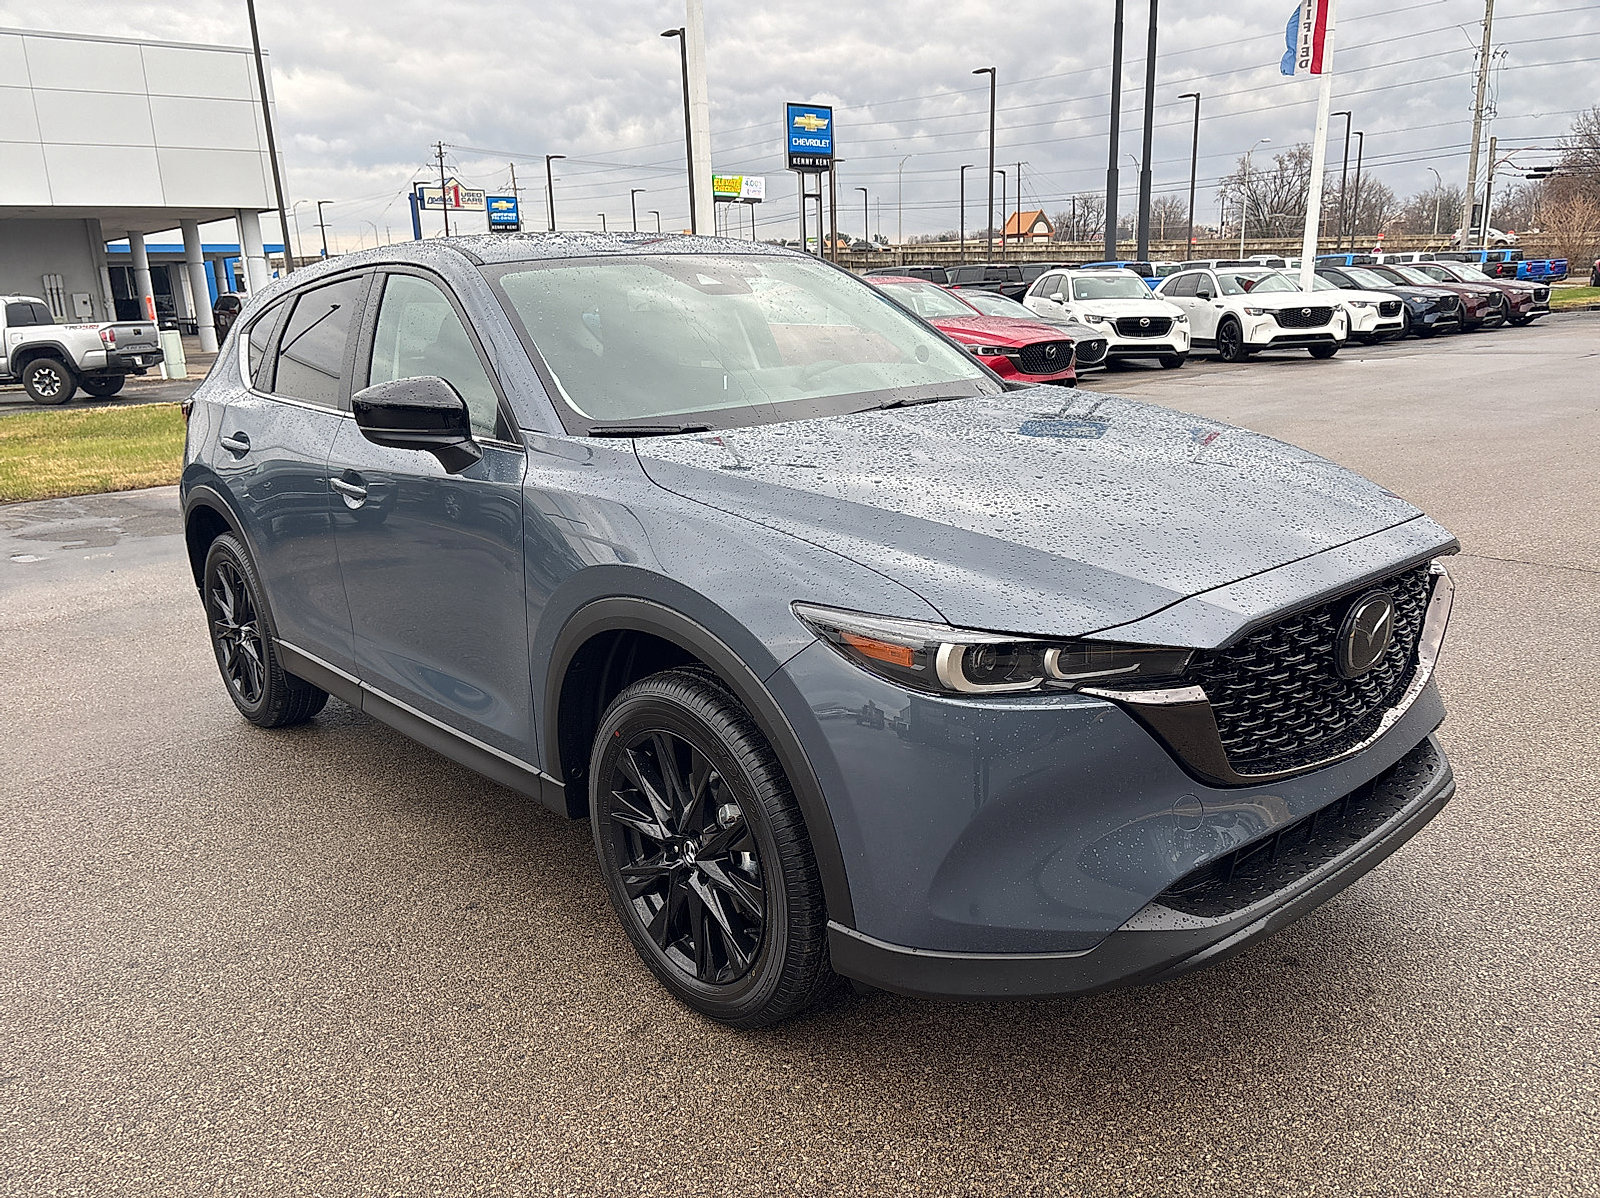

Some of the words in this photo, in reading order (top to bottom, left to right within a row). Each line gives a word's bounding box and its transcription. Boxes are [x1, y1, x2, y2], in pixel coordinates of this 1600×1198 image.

[792, 137, 830, 148] CHEVROLET
[792, 157, 813, 166] KENNY
[815, 158, 830, 167] KENT
